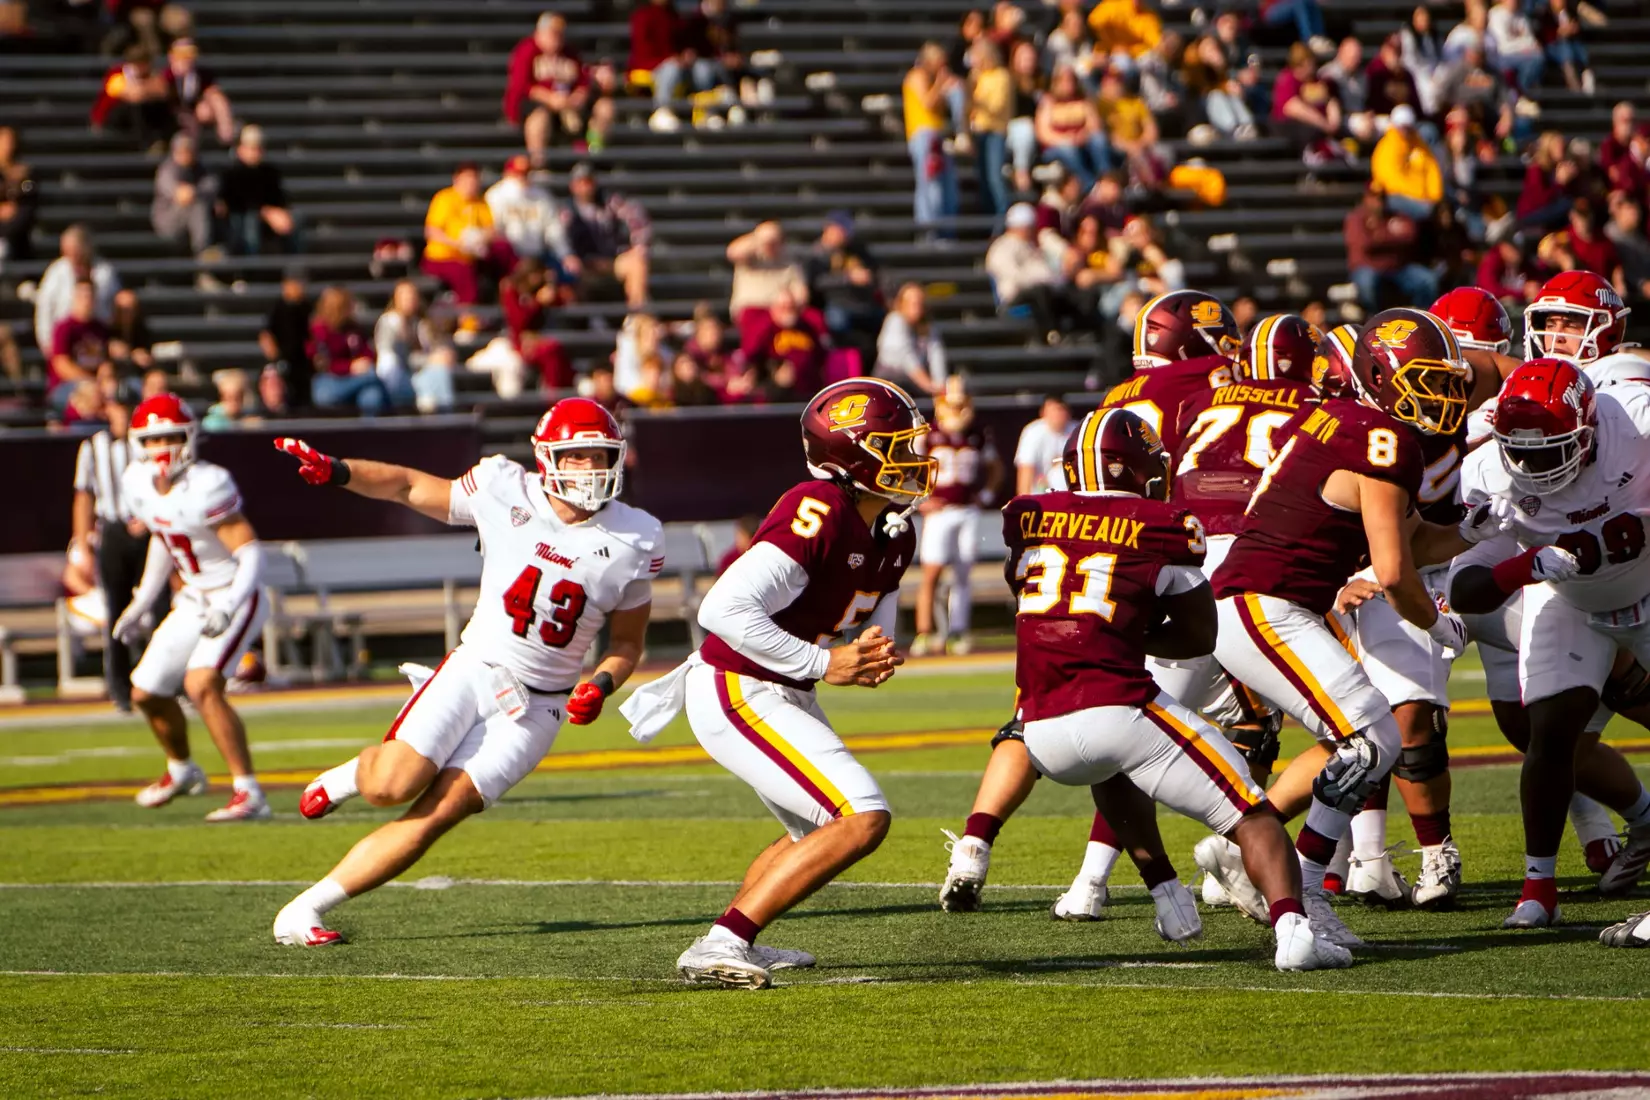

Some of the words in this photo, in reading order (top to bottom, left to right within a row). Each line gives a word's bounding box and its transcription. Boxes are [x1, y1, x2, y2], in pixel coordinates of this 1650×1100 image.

[1212, 384, 1299, 409] RUSSELL
[1366, 427, 1398, 467] 8
[790, 496, 831, 539] 5
[1020, 511, 1145, 550] CLERVEAUX
[534, 541, 581, 569] Miami
[1015, 543, 1119, 624] 31
[502, 563, 589, 649] 43
